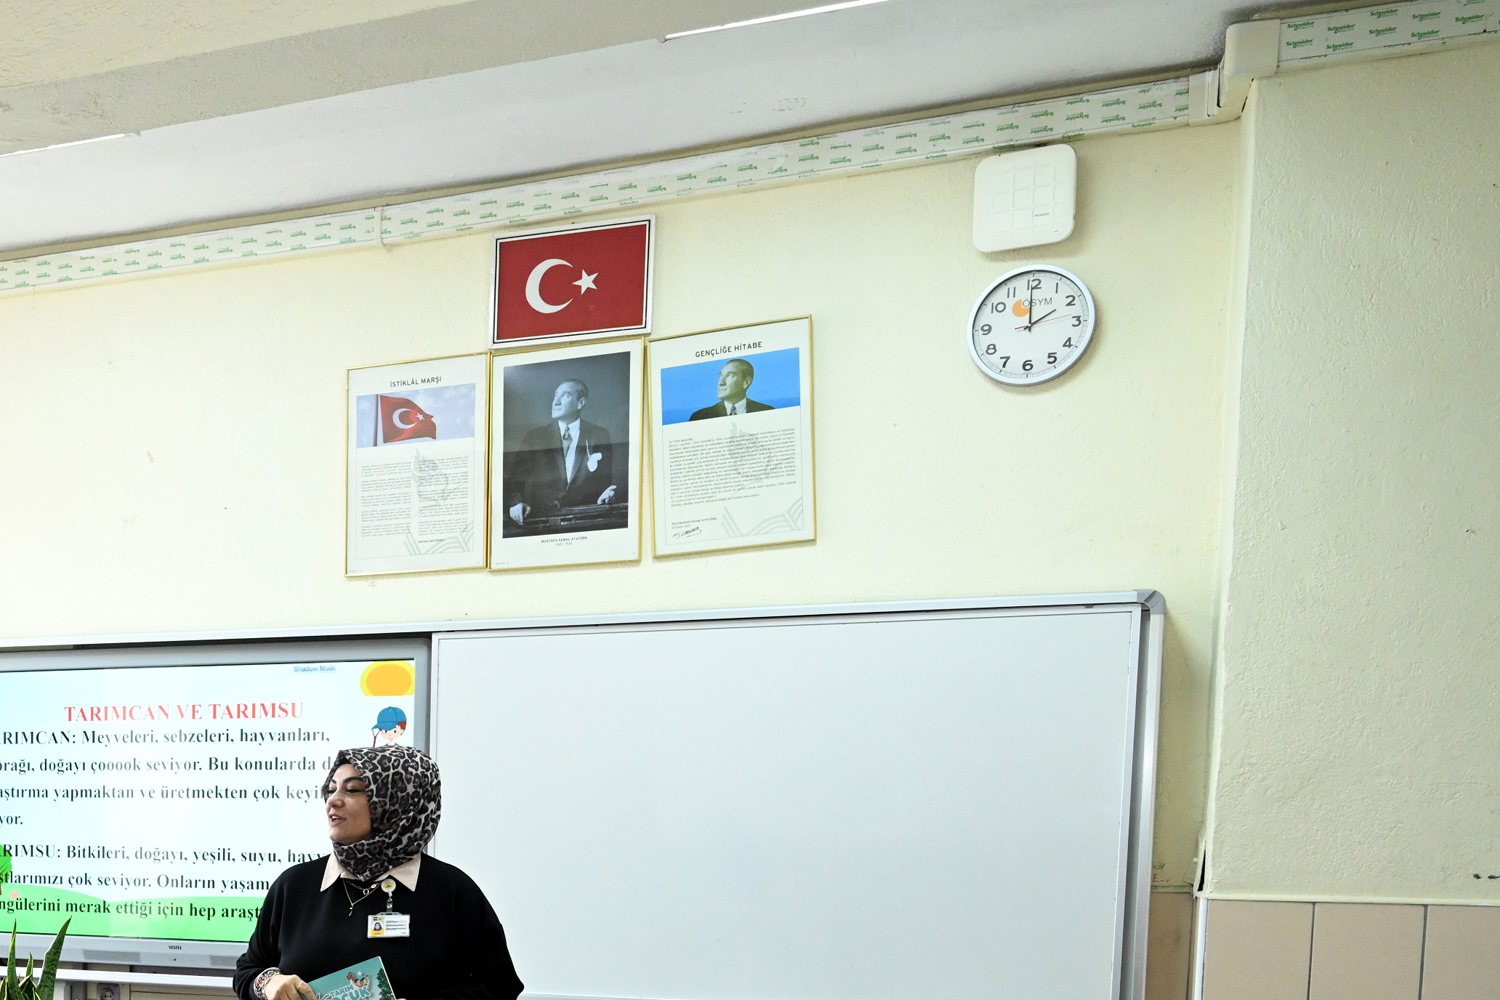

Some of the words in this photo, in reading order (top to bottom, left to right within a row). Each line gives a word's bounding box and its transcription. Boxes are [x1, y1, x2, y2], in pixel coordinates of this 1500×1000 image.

[1370, 8, 1398, 19] Schneider
[1412, 11, 1441, 22] Schneider
[1455, 13, 1484, 24] Schneider
[1287, 20, 1315, 31] Schneider
[1327, 23, 1355, 34] Schneider
[1368, 27, 1397, 38] Schneider
[1411, 29, 1440, 40] Schneider
[1286, 39, 1314, 49] Schneider
[1326, 41, 1354, 52] Schneider
[1027, 279, 1042, 290] 12
[1055, 282, 1059, 294] 1
[1007, 287, 1016, 298] 11
[1022, 297, 1053, 308] ÖSYM
[1065, 295, 1076, 307] 2
[991, 302, 1006, 314] 10
[1072, 315, 1081, 327] 3
[981, 324, 992, 335] 9
[1063, 337, 1073, 349] 4
[695, 345, 732, 358] GENÇLİĞE
[734, 341, 763, 352] HİTABE
[986, 344, 997, 355] 8
[1000, 356, 1010, 368] 7
[1047, 352, 1057, 364] 5
[1022, 360, 1033, 371] 6
[389, 378, 419, 388] İSTİKLÂL
[420, 376, 442, 385] MARŞI
[64, 705, 170, 722] TARIMCAN
[177, 704, 203, 720] VE
[208, 702, 304, 720] TARIMSU
[82, 729, 159, 748] Meyveleri,
[163, 728, 234, 743] sebzeleri,
[240, 727, 330, 746] hayvanları,
[39, 758, 86, 775] doğayı
[90, 758, 141, 774] çooook
[146, 757, 202, 774] seviyor.
[208, 756, 229, 771] Bu
[235, 756, 316, 770] konularda
[53, 786, 134, 802] yapmaktan
[139, 788, 156, 799] ve
[160, 785, 248, 799] üretmekten
[253, 785, 280, 802] çok
[67, 845, 130, 861] Bitkileri,
[134, 847, 188, 864] doğayı,
[192, 847, 236, 864] yeşili,
[240, 852, 282, 866] suyu,
[68, 872, 92, 888] çok
[97, 874, 152, 890] seviyor.
[157, 874, 216, 889] Onların
[220, 879, 270, 893] yaşam
[65, 900, 111, 914] merak
[116, 901, 152, 919] ettiği
[157, 902, 184, 918] için
[189, 903, 216, 921] hep
[331, 985, 354, 997] TARIM
